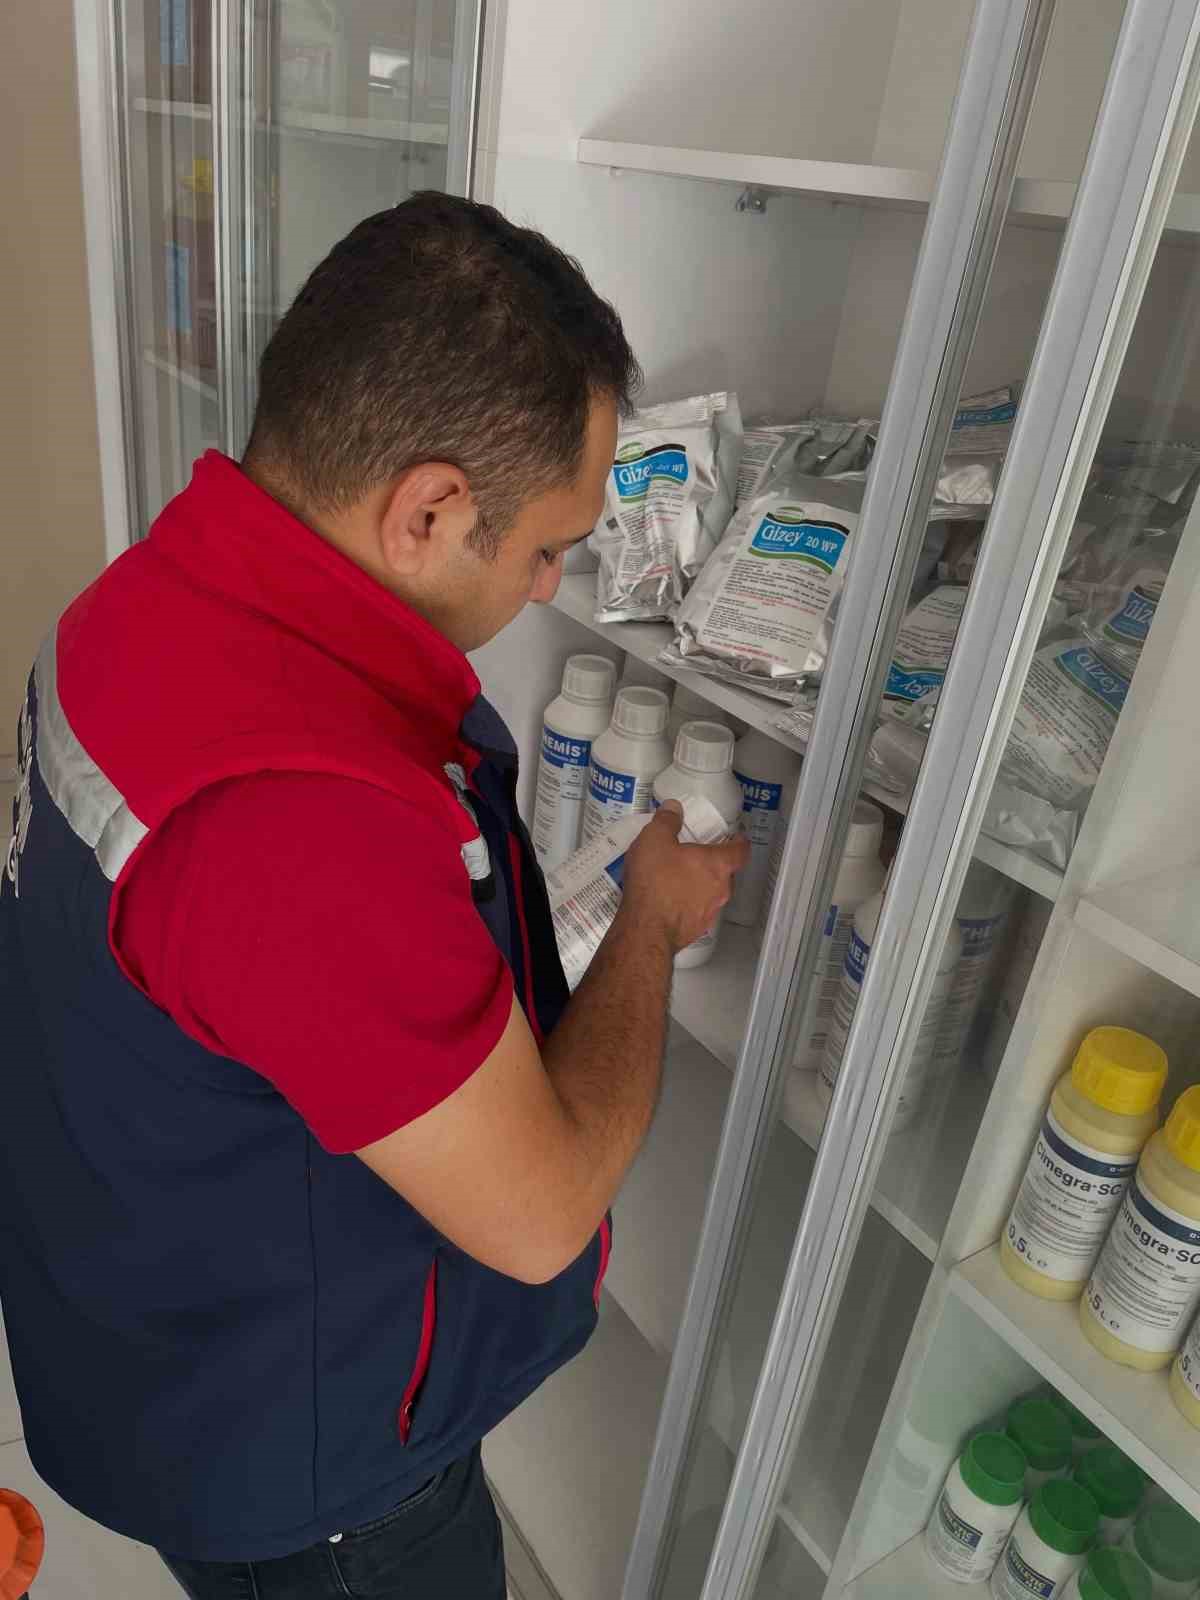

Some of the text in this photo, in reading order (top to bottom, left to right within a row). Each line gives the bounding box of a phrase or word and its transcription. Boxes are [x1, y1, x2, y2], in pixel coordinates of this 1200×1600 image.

[619, 464, 655, 485] Gize
[761, 523, 805, 547] Gizey
[805, 535, 820, 549] 20
[1036, 1141, 1092, 1192] Cimegra
